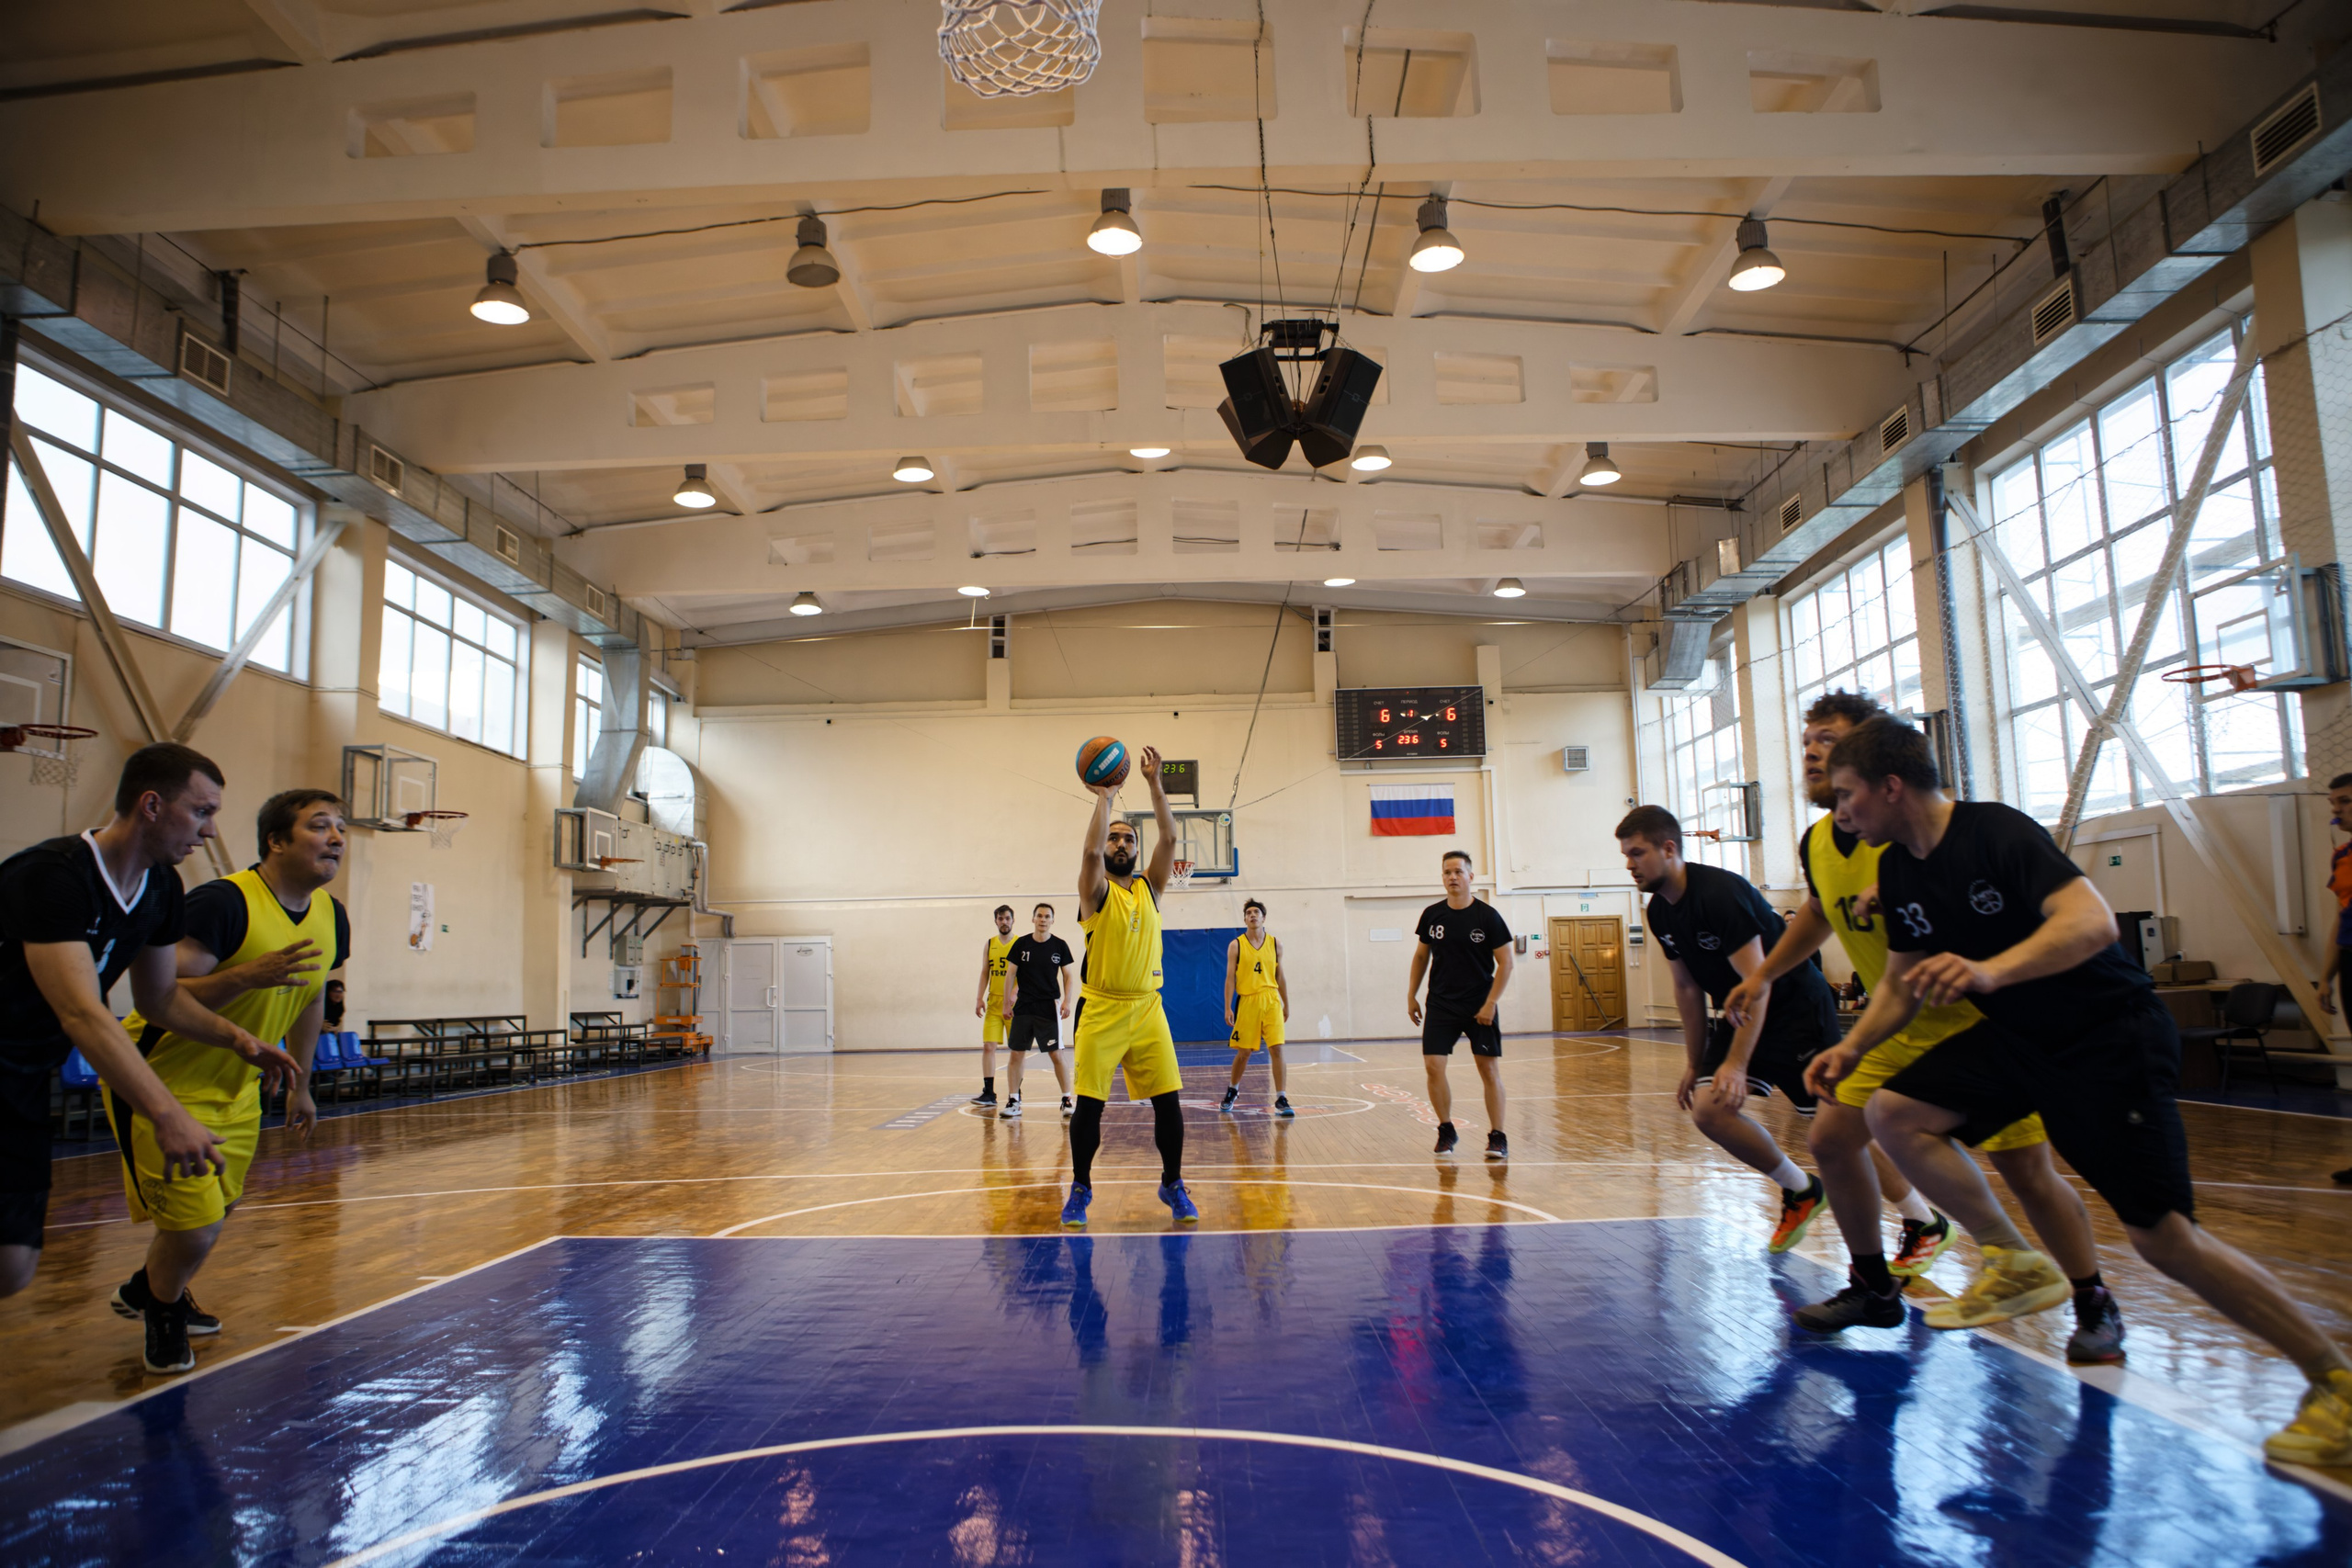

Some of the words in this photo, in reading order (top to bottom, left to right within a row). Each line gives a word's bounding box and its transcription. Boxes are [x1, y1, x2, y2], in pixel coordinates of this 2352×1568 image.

[1380, 708, 1390, 723] 6
[1408, 709, 1414, 717] 1
[1446, 707, 1456, 721] 6
[1375, 739, 1383, 750] 5
[1440, 738, 1447, 748] 5
[1895, 902, 1934, 938] 33
[1429, 924, 1445, 940] 48
[999, 957, 1006, 969] 5
[1021, 951, 1030, 962] 21
[1253, 961, 1262, 975] 4
[1231, 1030, 1240, 1043] 4
